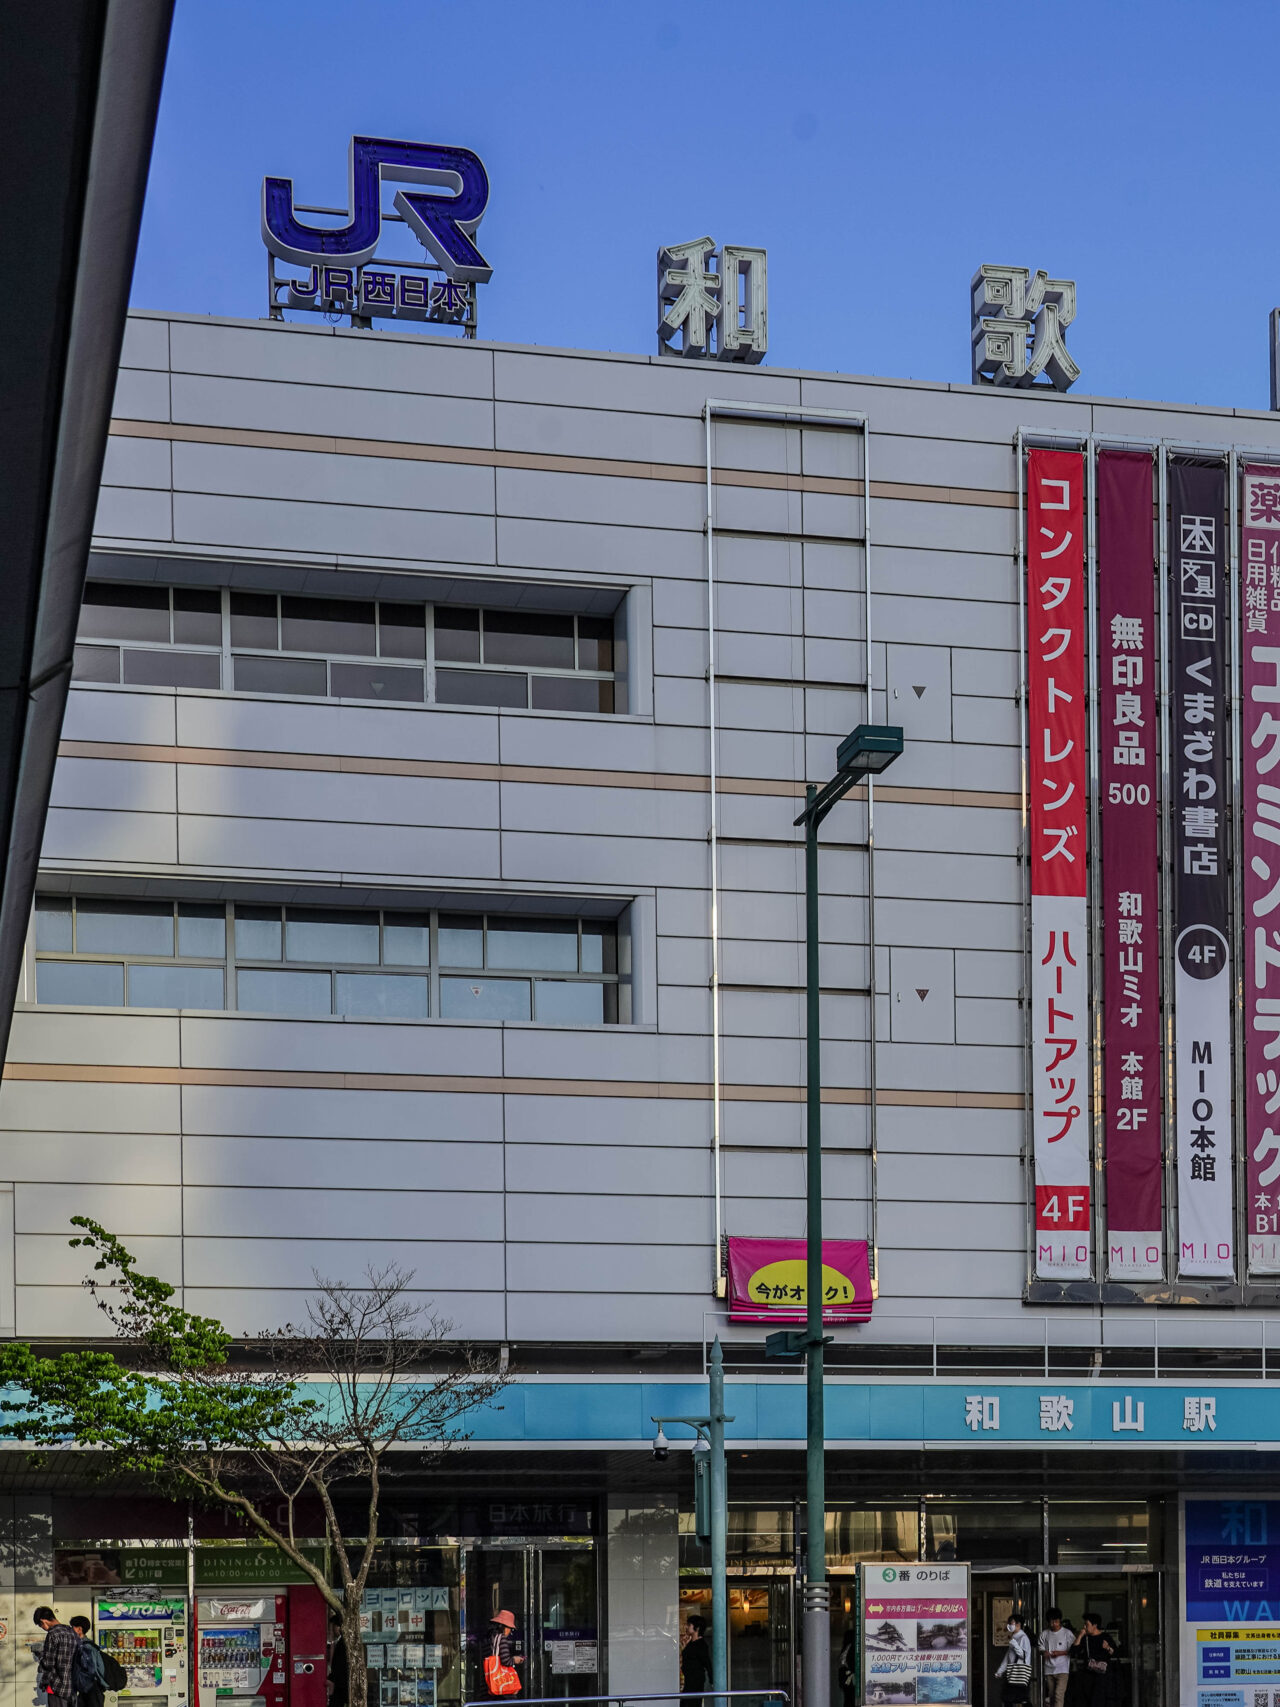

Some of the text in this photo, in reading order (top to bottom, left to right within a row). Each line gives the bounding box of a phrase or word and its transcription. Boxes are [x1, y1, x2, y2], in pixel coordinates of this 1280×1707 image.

[262, 135, 493, 283] JR
[289, 264, 468, 313] JR西日本
[1246, 539, 1268, 635] 日用雑貨
[1183, 612, 1213, 631] CD
[1039, 478, 1078, 863] コンタクトレンズ
[1110, 614, 1145, 767] 無印良品
[1182, 656, 1219, 876] くまざわ書店
[1108, 783, 1150, 805] 500
[1118, 891, 1143, 1028] 和歌山ミオ
[1188, 945, 1216, 963] 4F
[1041, 931, 1080, 1143] ハートアップ
[1120, 1051, 1143, 1100] 本館
[1117, 1108, 1148, 1130] 2F
[1190, 1040, 1217, 1182] MIO本館
[1042, 1196, 1084, 1222] 4F
[1039, 1245, 1088, 1262] MIO
[1110, 1246, 1159, 1263] MIO
[1182, 1243, 1230, 1260] MIO
[755, 1282, 849, 1300] 今がオク!
[964, 1394, 1218, 1434] 和歌山駅
[489, 1504, 577, 1523] 日本旅行
[204, 1558, 316, 1567] DINING STRT
[916, 1570, 950, 1581] のりば
[128, 1604, 173, 1615] ITO EN
